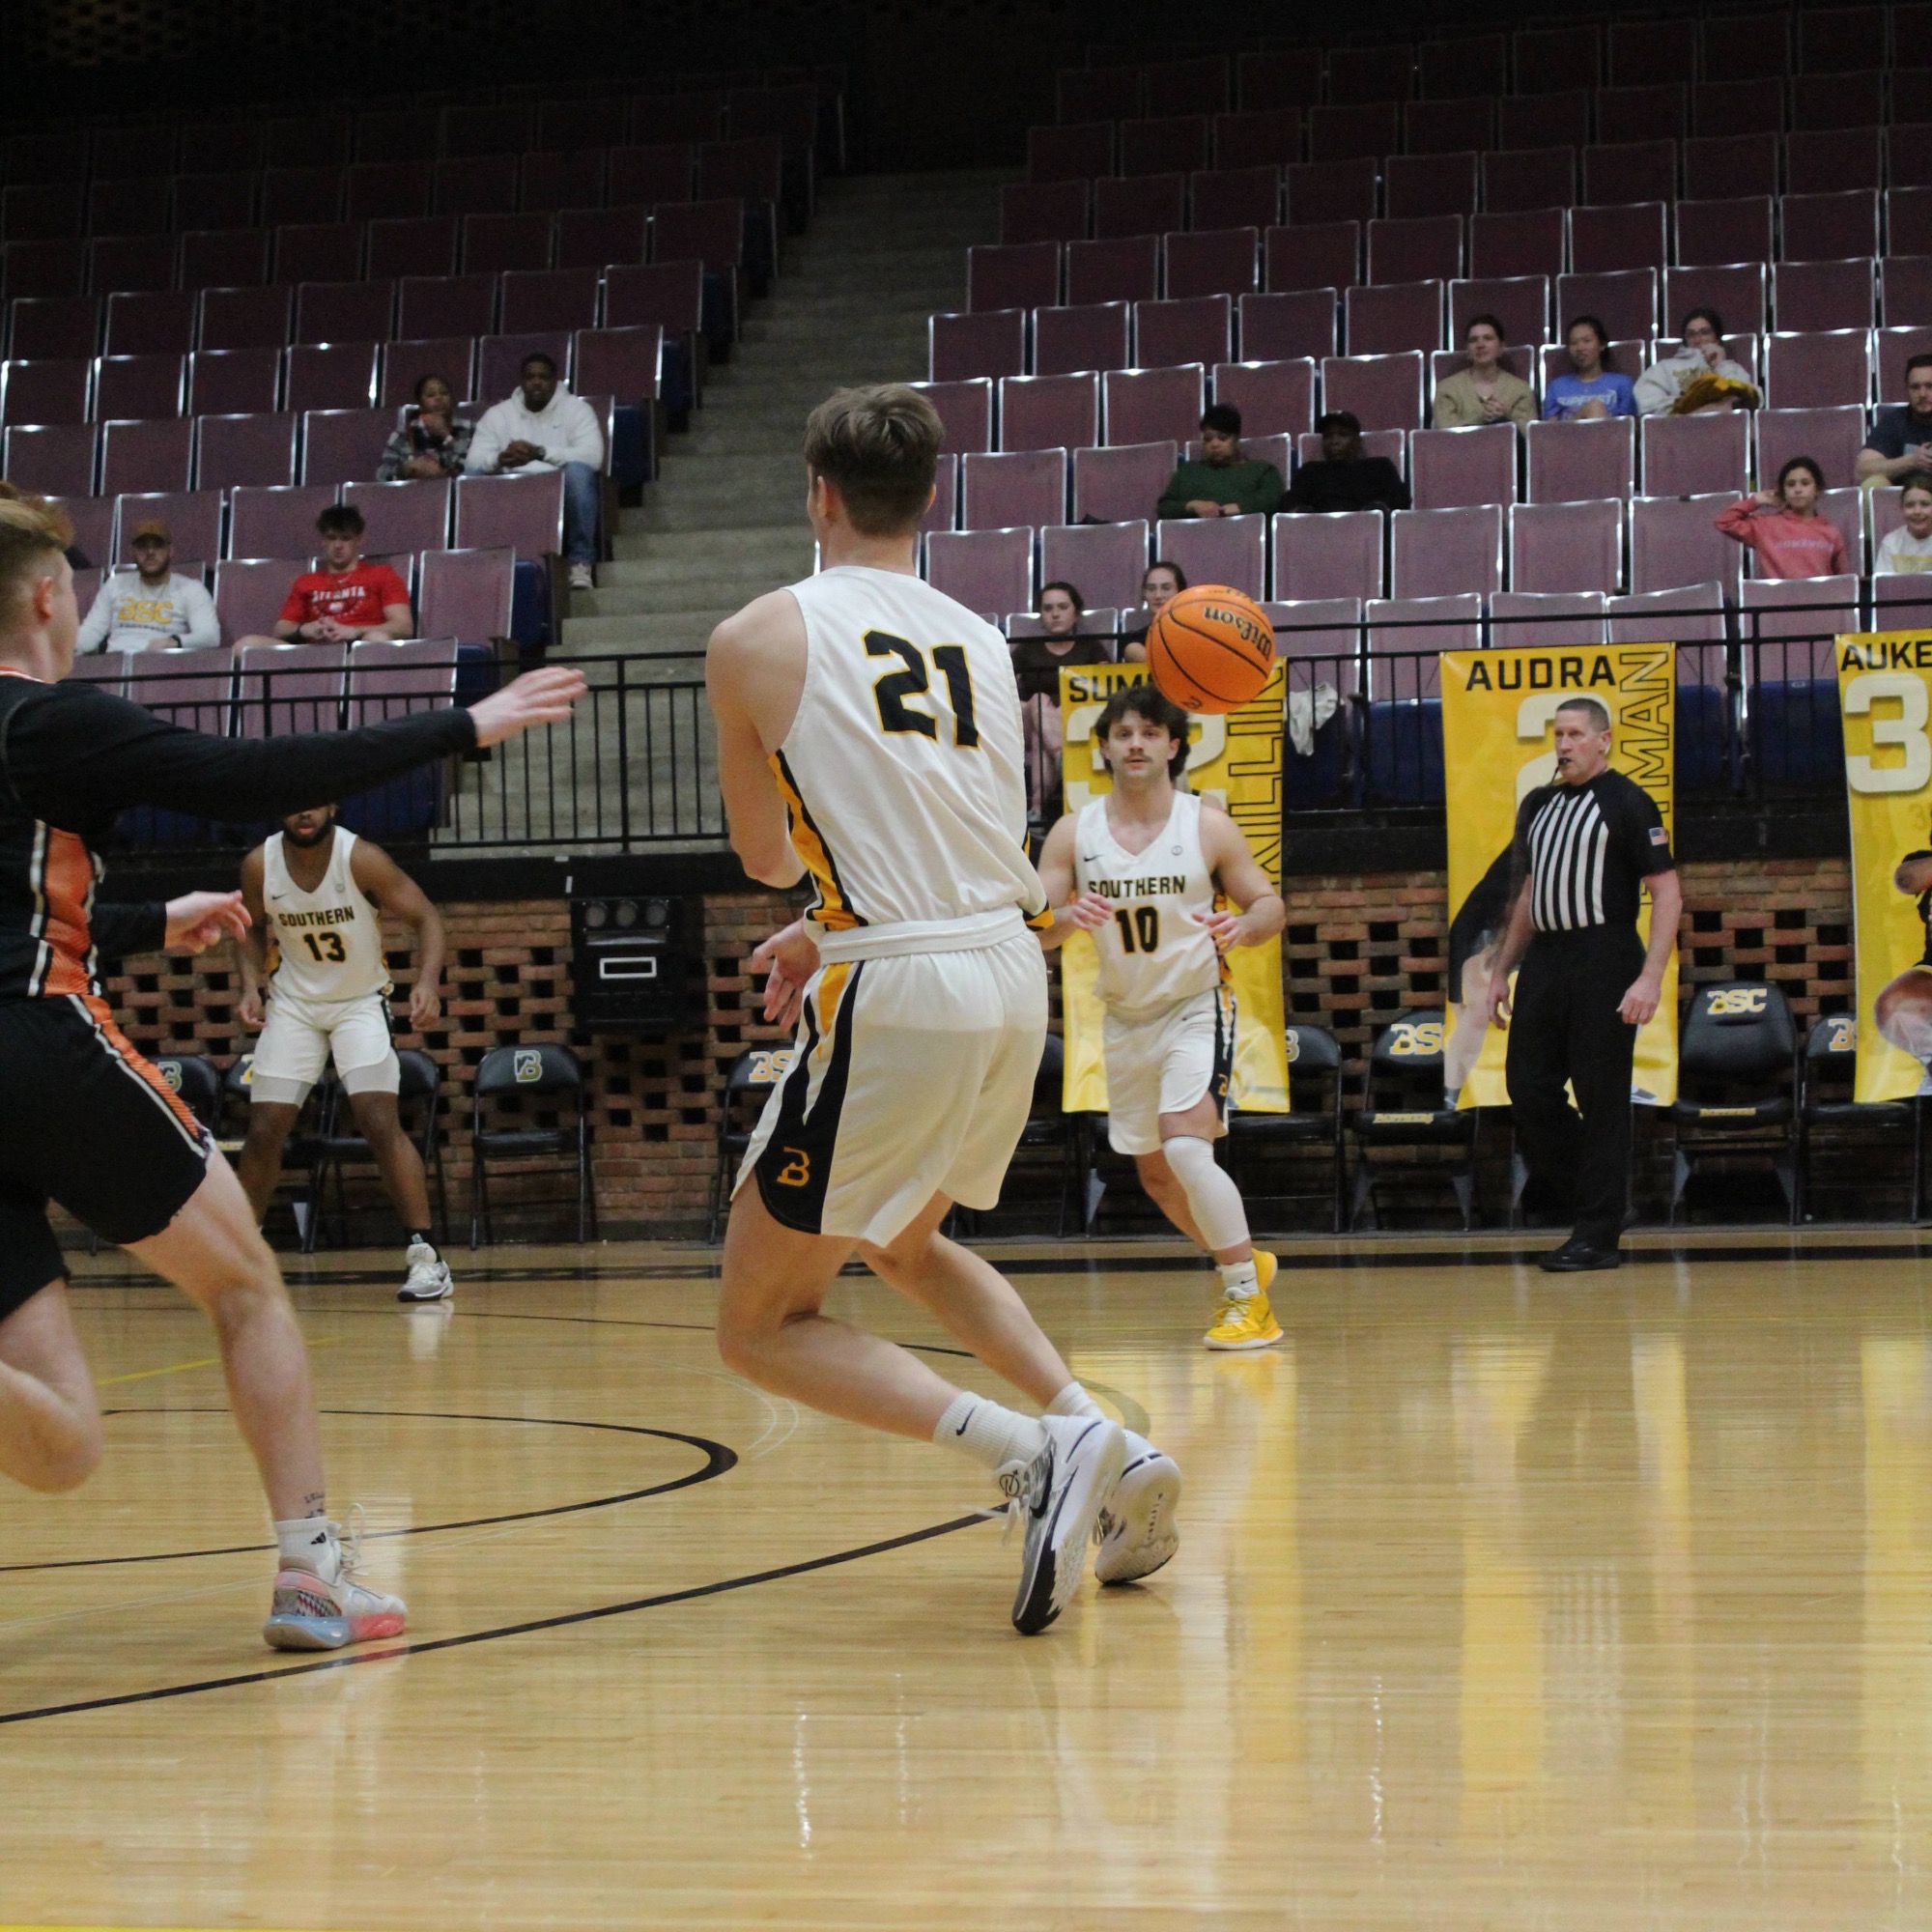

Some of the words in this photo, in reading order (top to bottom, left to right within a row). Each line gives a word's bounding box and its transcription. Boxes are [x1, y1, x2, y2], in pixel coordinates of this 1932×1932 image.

[861, 628, 981, 752] 21
[1465, 654, 1617, 692] AUDRA
[1844, 672, 1931, 794] 3
[1088, 875, 1186, 899] SOUTHERN
[277, 905, 355, 927] SOUTHERN
[1115, 904, 1159, 954] 10
[301, 931, 347, 962] 13
[1707, 988, 1768, 1014] BSC
